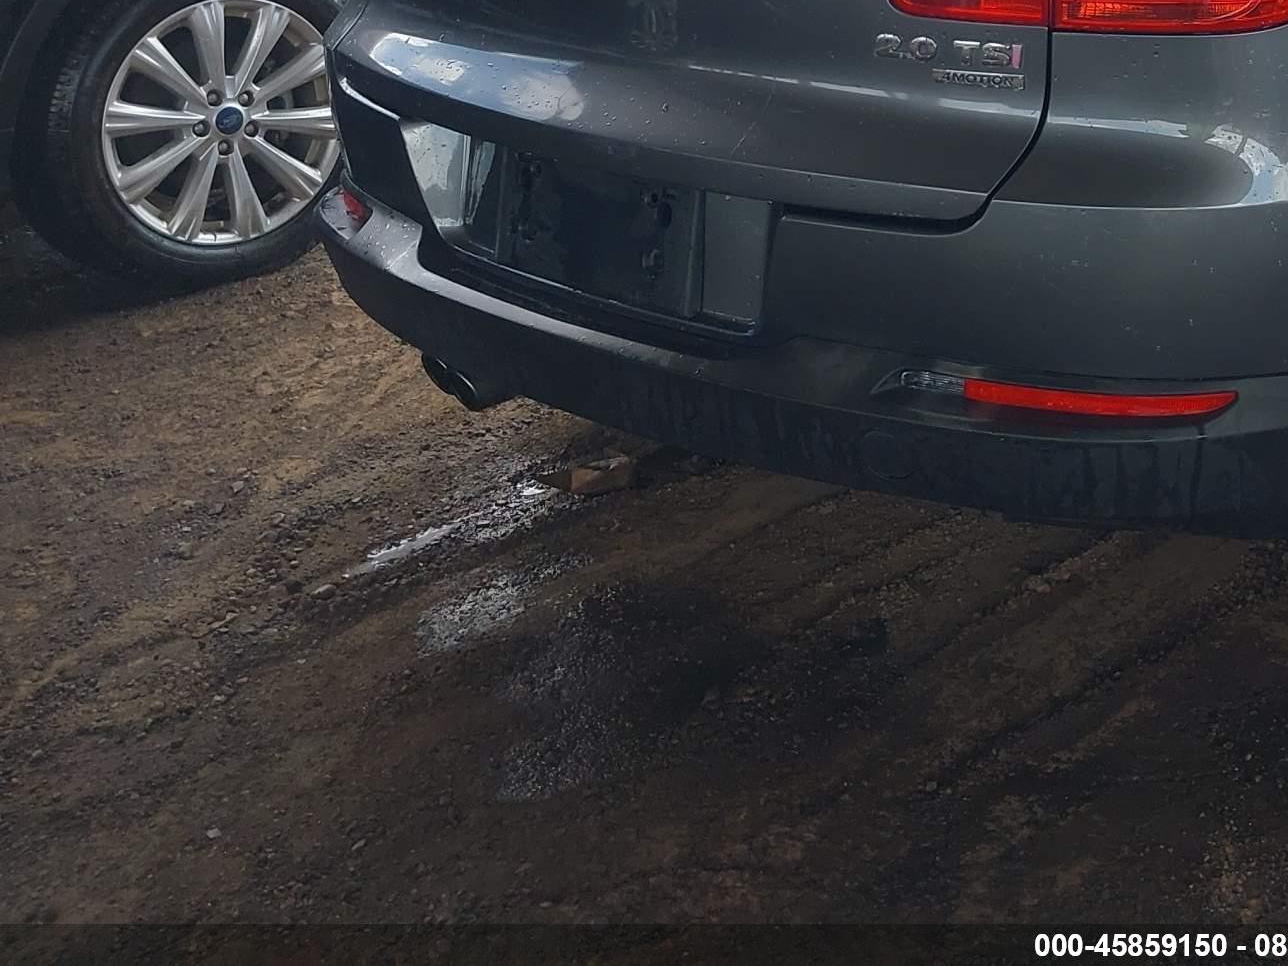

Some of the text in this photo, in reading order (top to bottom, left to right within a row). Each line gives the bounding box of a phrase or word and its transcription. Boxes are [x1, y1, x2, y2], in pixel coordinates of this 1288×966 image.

[875, 33, 1023, 69] 2.0 TSI
[941, 73, 1016, 89] 4MOTION
